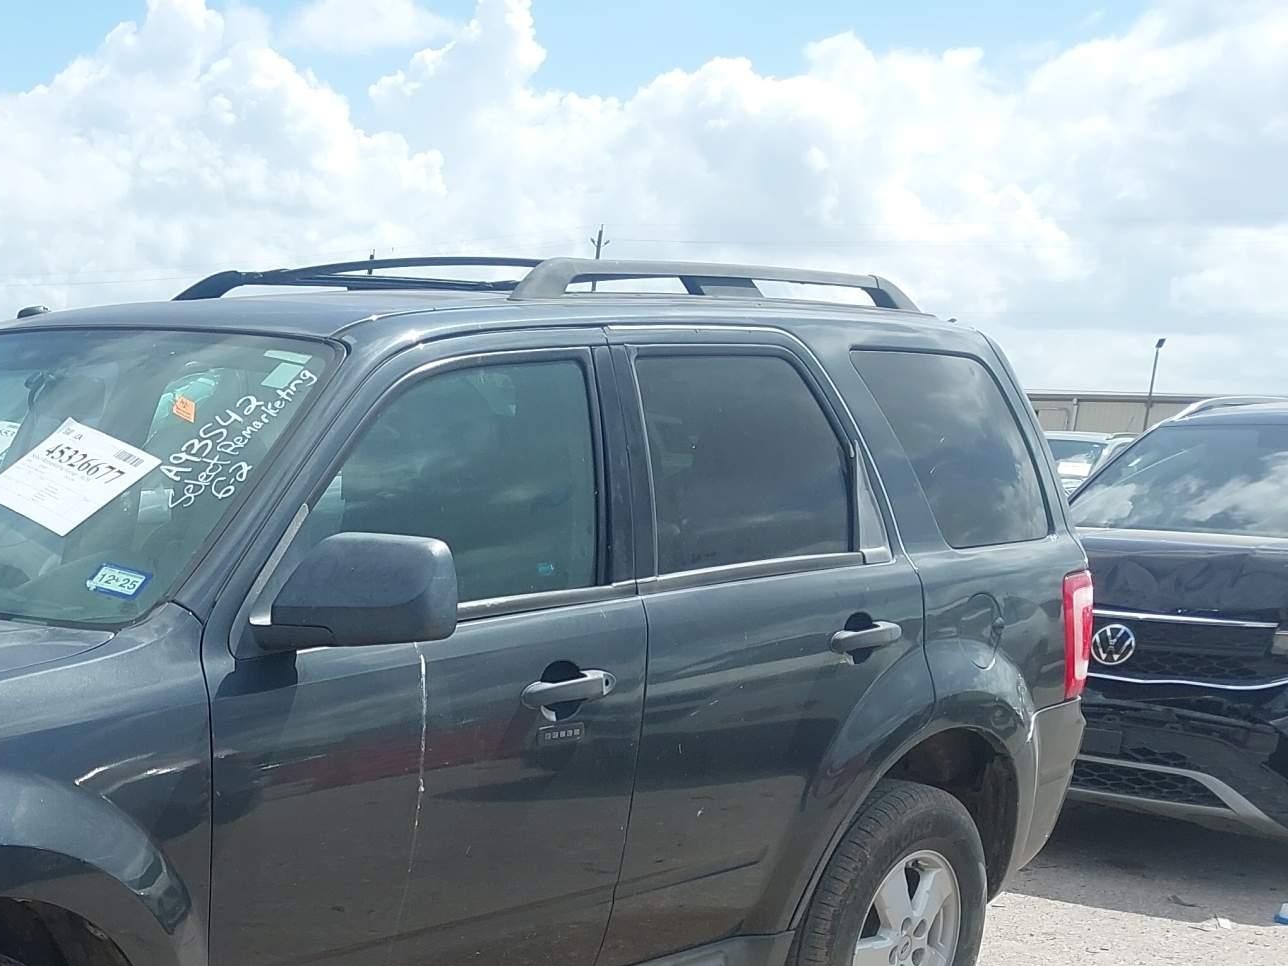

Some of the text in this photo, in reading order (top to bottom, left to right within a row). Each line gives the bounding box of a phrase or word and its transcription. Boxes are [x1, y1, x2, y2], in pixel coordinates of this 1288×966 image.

[45, 443, 126, 484] 45326677
[164, 369, 318, 508] Select Remarketing
